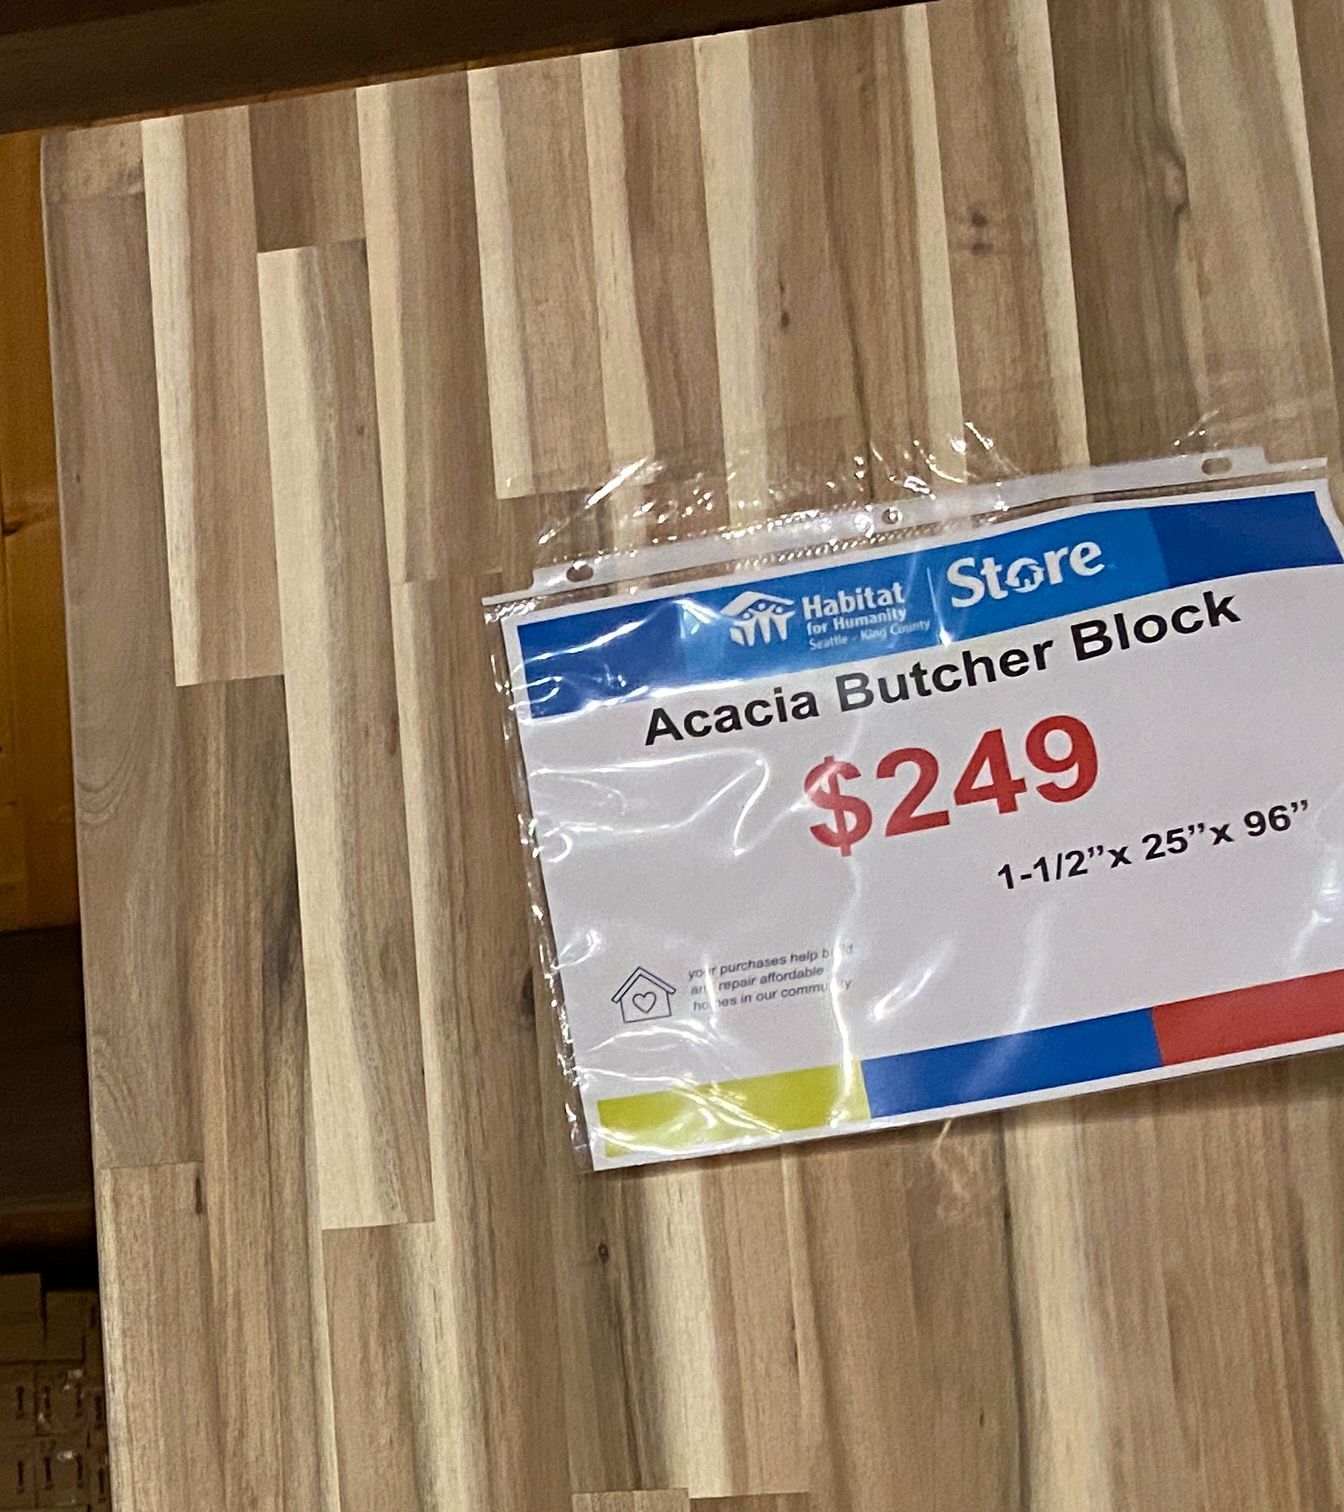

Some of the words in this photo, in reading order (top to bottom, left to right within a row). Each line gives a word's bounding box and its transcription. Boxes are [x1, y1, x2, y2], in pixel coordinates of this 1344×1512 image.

[946, 541, 1106, 608] Store
[802, 582, 906, 621] Habitat
[806, 619, 828, 636] for
[833, 607, 907, 632] Humanity
[809, 633, 849, 650] Seattle
[860, 626, 888, 645] King
[889, 619, 930, 637] County
[643, 686, 821, 747] Acacia
[835, 635, 1054, 714] Butcher
[1071, 590, 1243, 664] Block
[801, 714, 1101, 858] $249
[688, 966, 717, 981] yor
[720, 955, 787, 977] purchases
[790, 950, 818, 965] help
[719, 976, 757, 993] repair
[759, 966, 825, 985] affordable
[693, 997, 737, 1011] hoes
[740, 993, 753, 1004] in
[756, 989, 777, 1002] our
